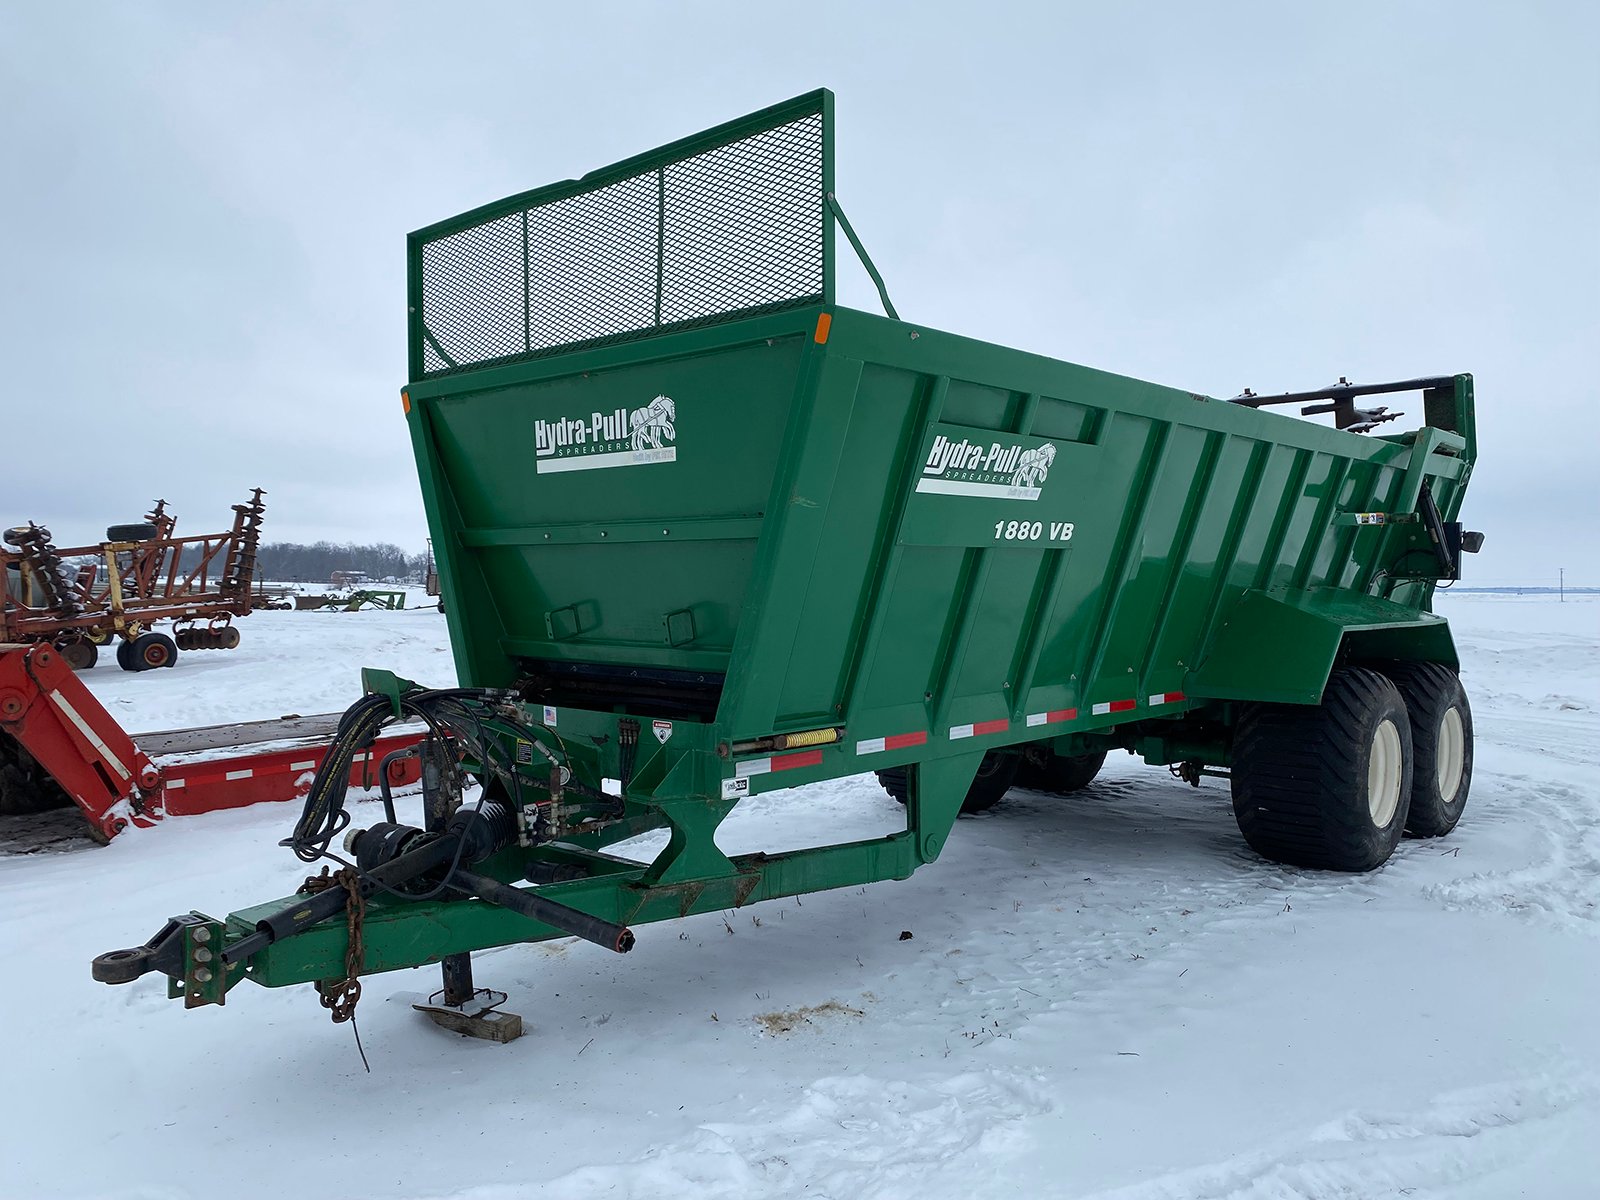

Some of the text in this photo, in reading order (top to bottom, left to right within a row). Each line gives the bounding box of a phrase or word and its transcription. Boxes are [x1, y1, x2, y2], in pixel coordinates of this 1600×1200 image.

[535, 408, 628, 456] Hydra-Pull
[558, 442, 630, 457] SPREADERS
[922, 435, 1022, 475] Hydra-Pull
[945, 471, 1012, 484] SPREADERS
[994, 520, 1075, 541] 1880 VB
